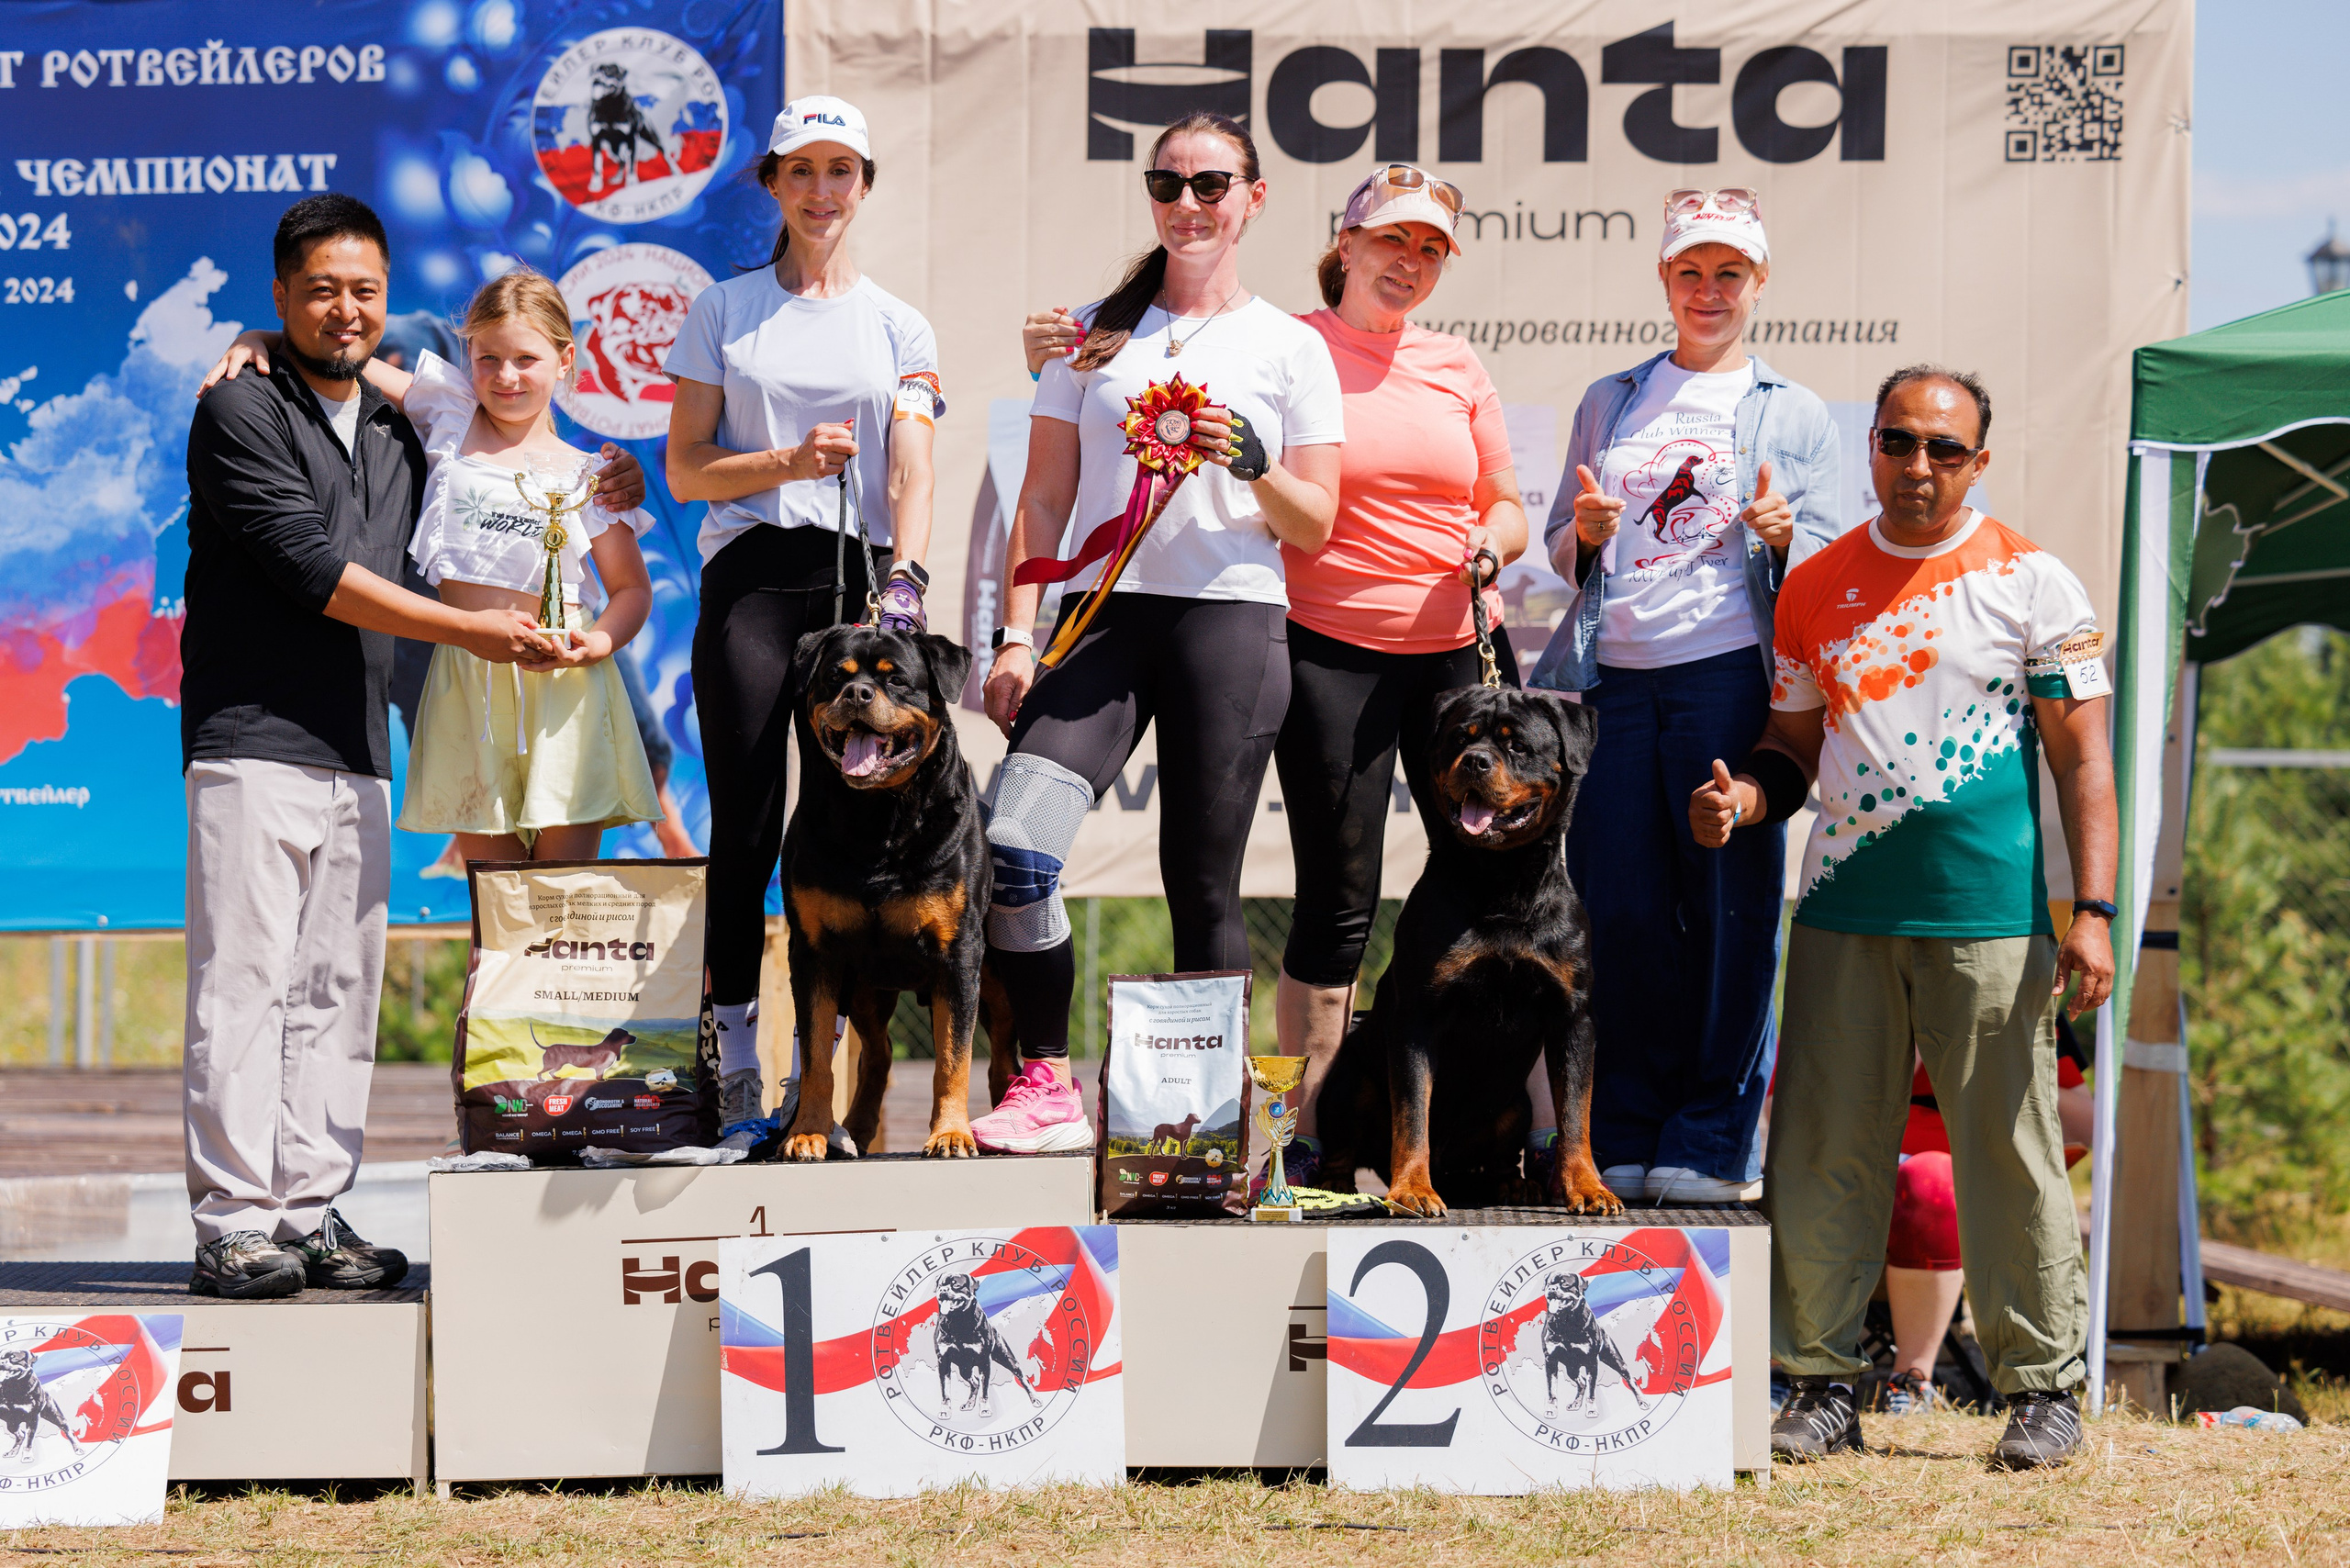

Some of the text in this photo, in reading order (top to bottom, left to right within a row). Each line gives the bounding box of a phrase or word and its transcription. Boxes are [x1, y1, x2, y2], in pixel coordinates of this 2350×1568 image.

[39, 39, 386, 89] РОТВЕЙЛЕРОВ
[621, 36, 688, 64] КЛУБ
[1089, 21, 1887, 162] Hanta
[803, 113, 846, 127] FILA
[15, 153, 338, 196] ЧЕМПИОНАТ
[1330, 201, 1635, 243] pmium
[4, 276, 75, 304] 2024
[1415, 317, 1899, 355] нсированног итания
[1675, 411, 1721, 425] Russia
[479, 518, 544, 537] WORLD
[1697, 555, 1729, 568] Tver
[2063, 638, 2099, 655] Hanta
[2079, 665, 2098, 684] 52
[529, 902, 558, 911] взрослых
[555, 892, 574, 901] сухой
[599, 913, 606, 922] и
[606, 913, 635, 923] рисом
[524, 937, 655, 961] Hanta
[561, 964, 613, 973] premium
[533, 990, 641, 1002] SMALL/MEDIUM
[1135, 1033, 1223, 1050] Hanta
[508, 1099, 528, 1113] NWC
[749, 1205, 775, 1237] 1
[875, 1241, 1088, 1400] РОТВЕЙЛЕР КЛУБ РОССИИ
[1483, 1241, 1695, 1398] РОТВЕЙЛЕР КЛУБ РОССИИ
[749, 1247, 845, 1456] 1
[1344, 1239, 1461, 1447] 2
[35, 1326, 104, 1352] КЛУБ
[107, 1354, 137, 1445] РОССИИ
[929, 1417, 1045, 1450] РКФ-НКПР
[1535, 1419, 1651, 1450] РКФ-НКПР
